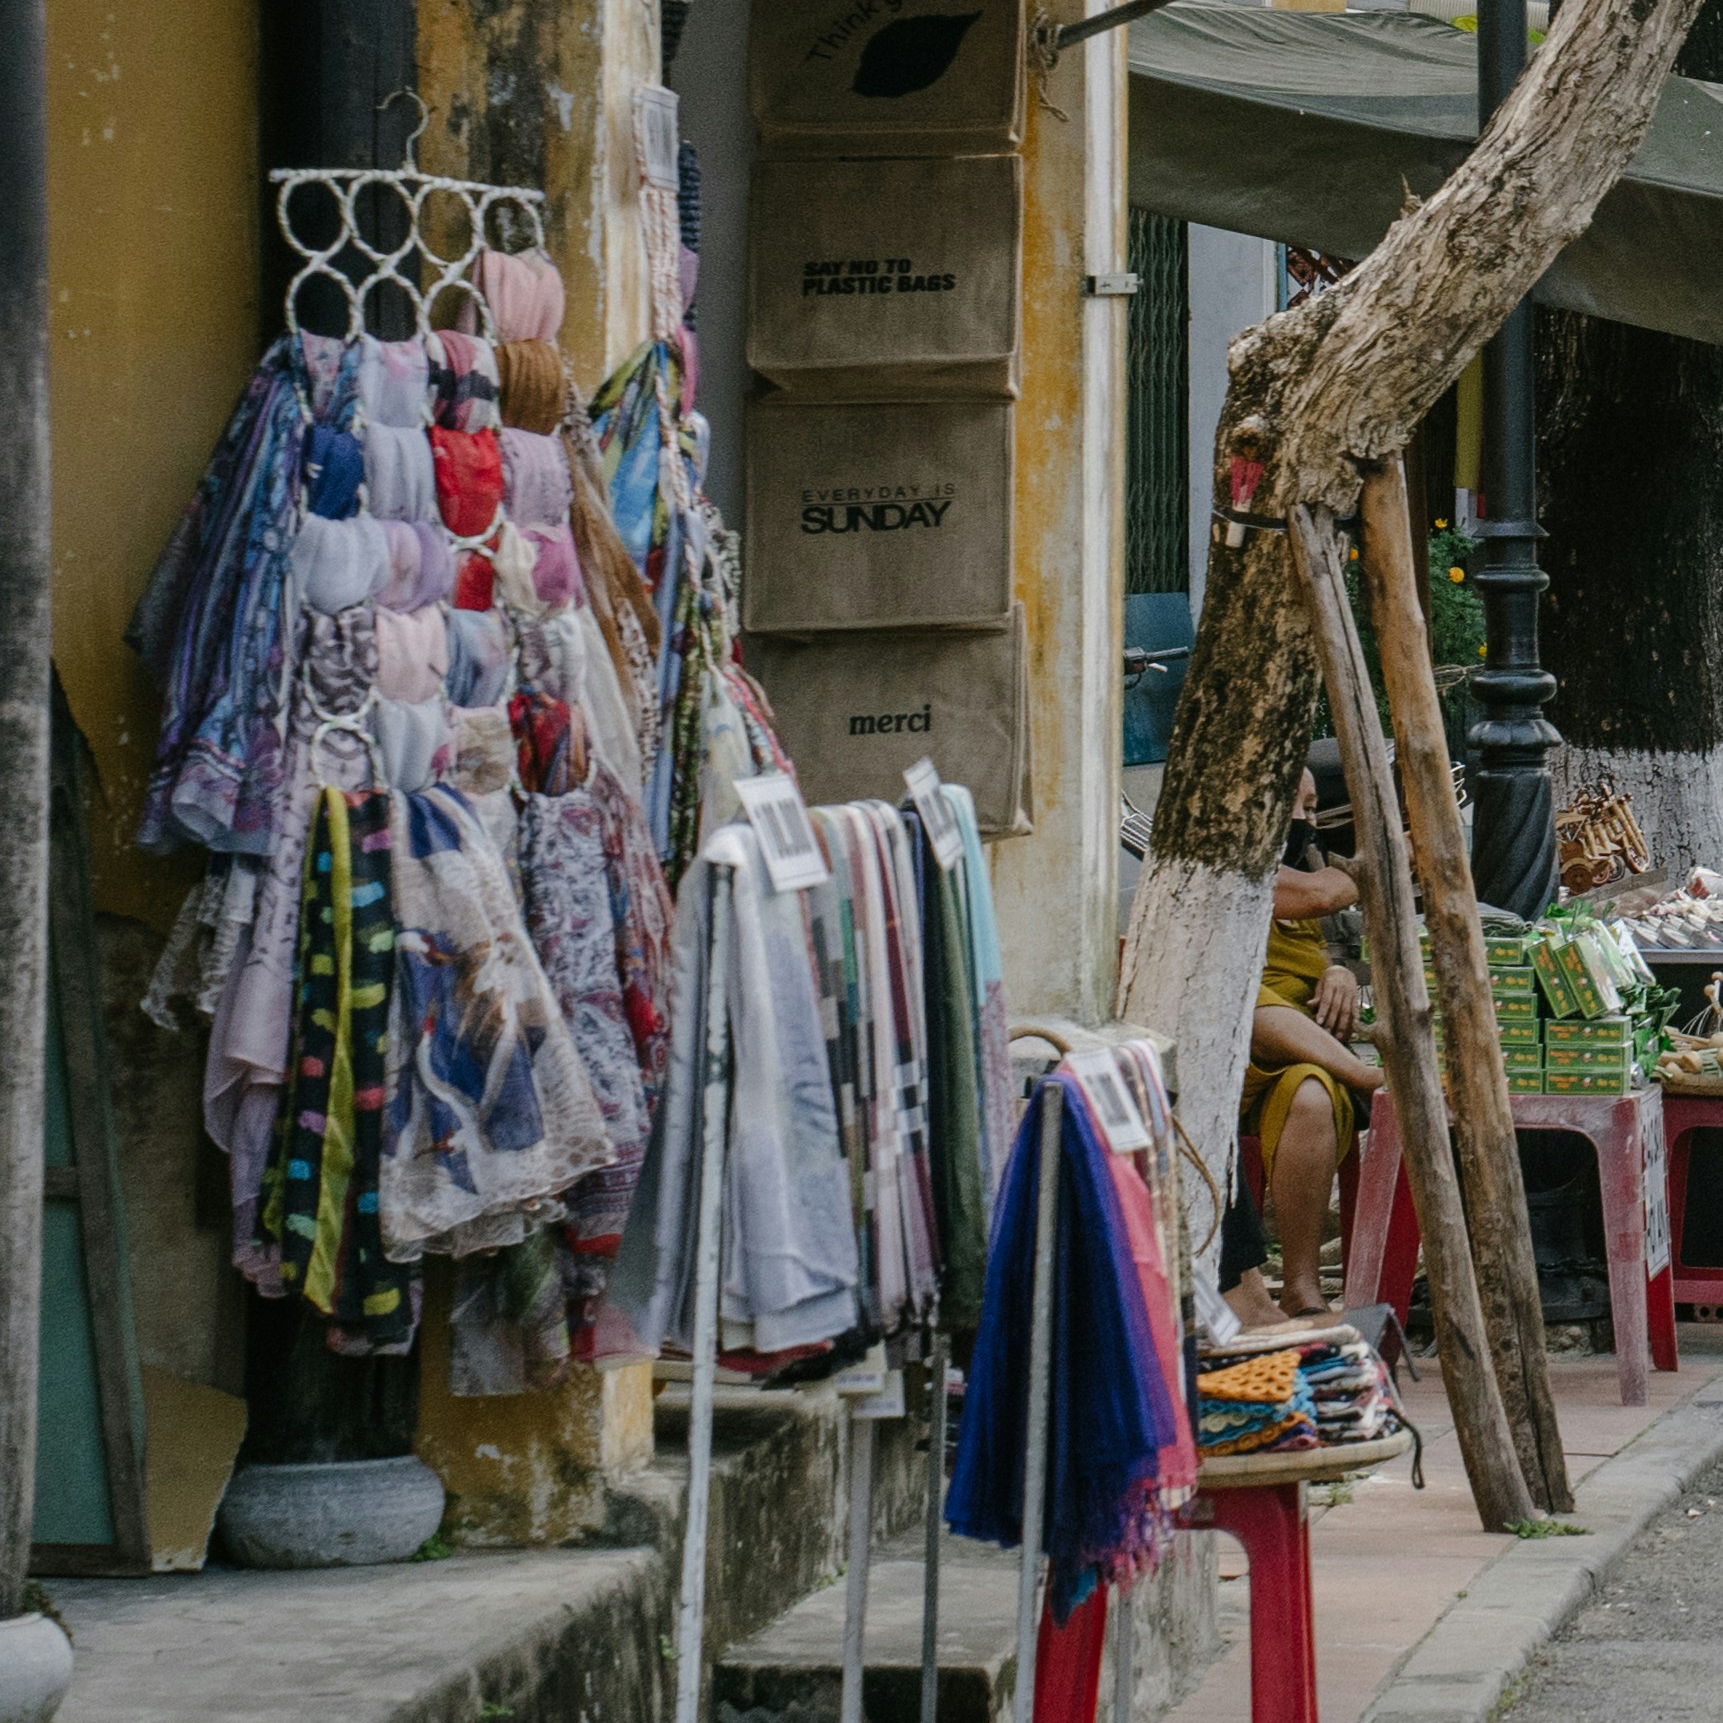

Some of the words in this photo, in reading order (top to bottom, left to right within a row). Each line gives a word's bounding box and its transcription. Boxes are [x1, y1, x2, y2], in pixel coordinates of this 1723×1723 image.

[805, 0, 881, 61] Think
[804, 261, 843, 275] SAY
[848, 260, 879, 275] NO
[885, 258, 912, 274] TO
[802, 276, 893, 296] PLASTIC
[897, 274, 955, 293] BAGS
[803, 485, 920, 502] EVERYDAY
[934, 482, 955, 496] IS
[801, 501, 952, 535] SUNDAY
[849, 703, 932, 735] merci
